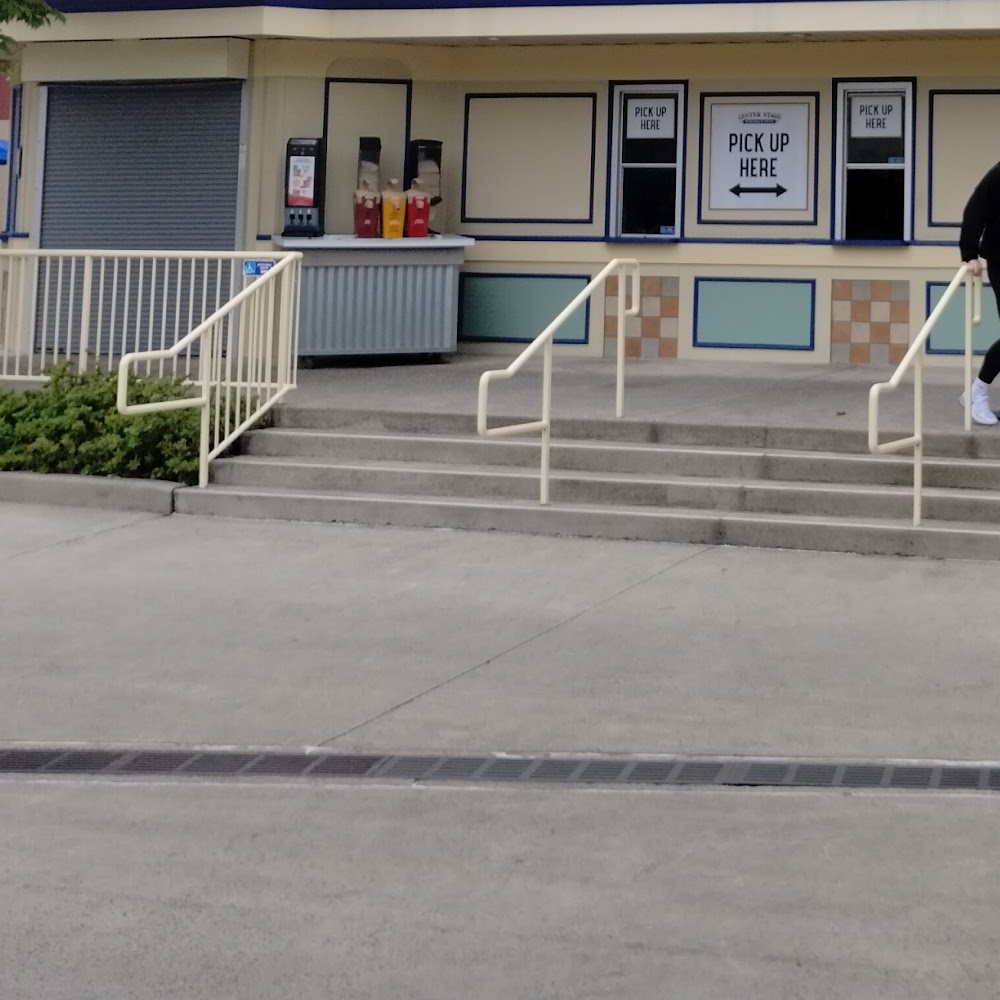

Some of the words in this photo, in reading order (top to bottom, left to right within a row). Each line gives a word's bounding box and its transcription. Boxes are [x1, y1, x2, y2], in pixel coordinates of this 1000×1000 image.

[635, 106, 654, 117] PICK
[655, 106, 667, 117] UP
[859, 104, 879, 116] PICK
[881, 104, 893, 116] UP
[640, 119, 661, 130] HERE
[865, 117, 887, 129] HERE
[729, 133, 764, 152] PICK
[770, 133, 789, 152] UP
[740, 157, 778, 177] HERE
